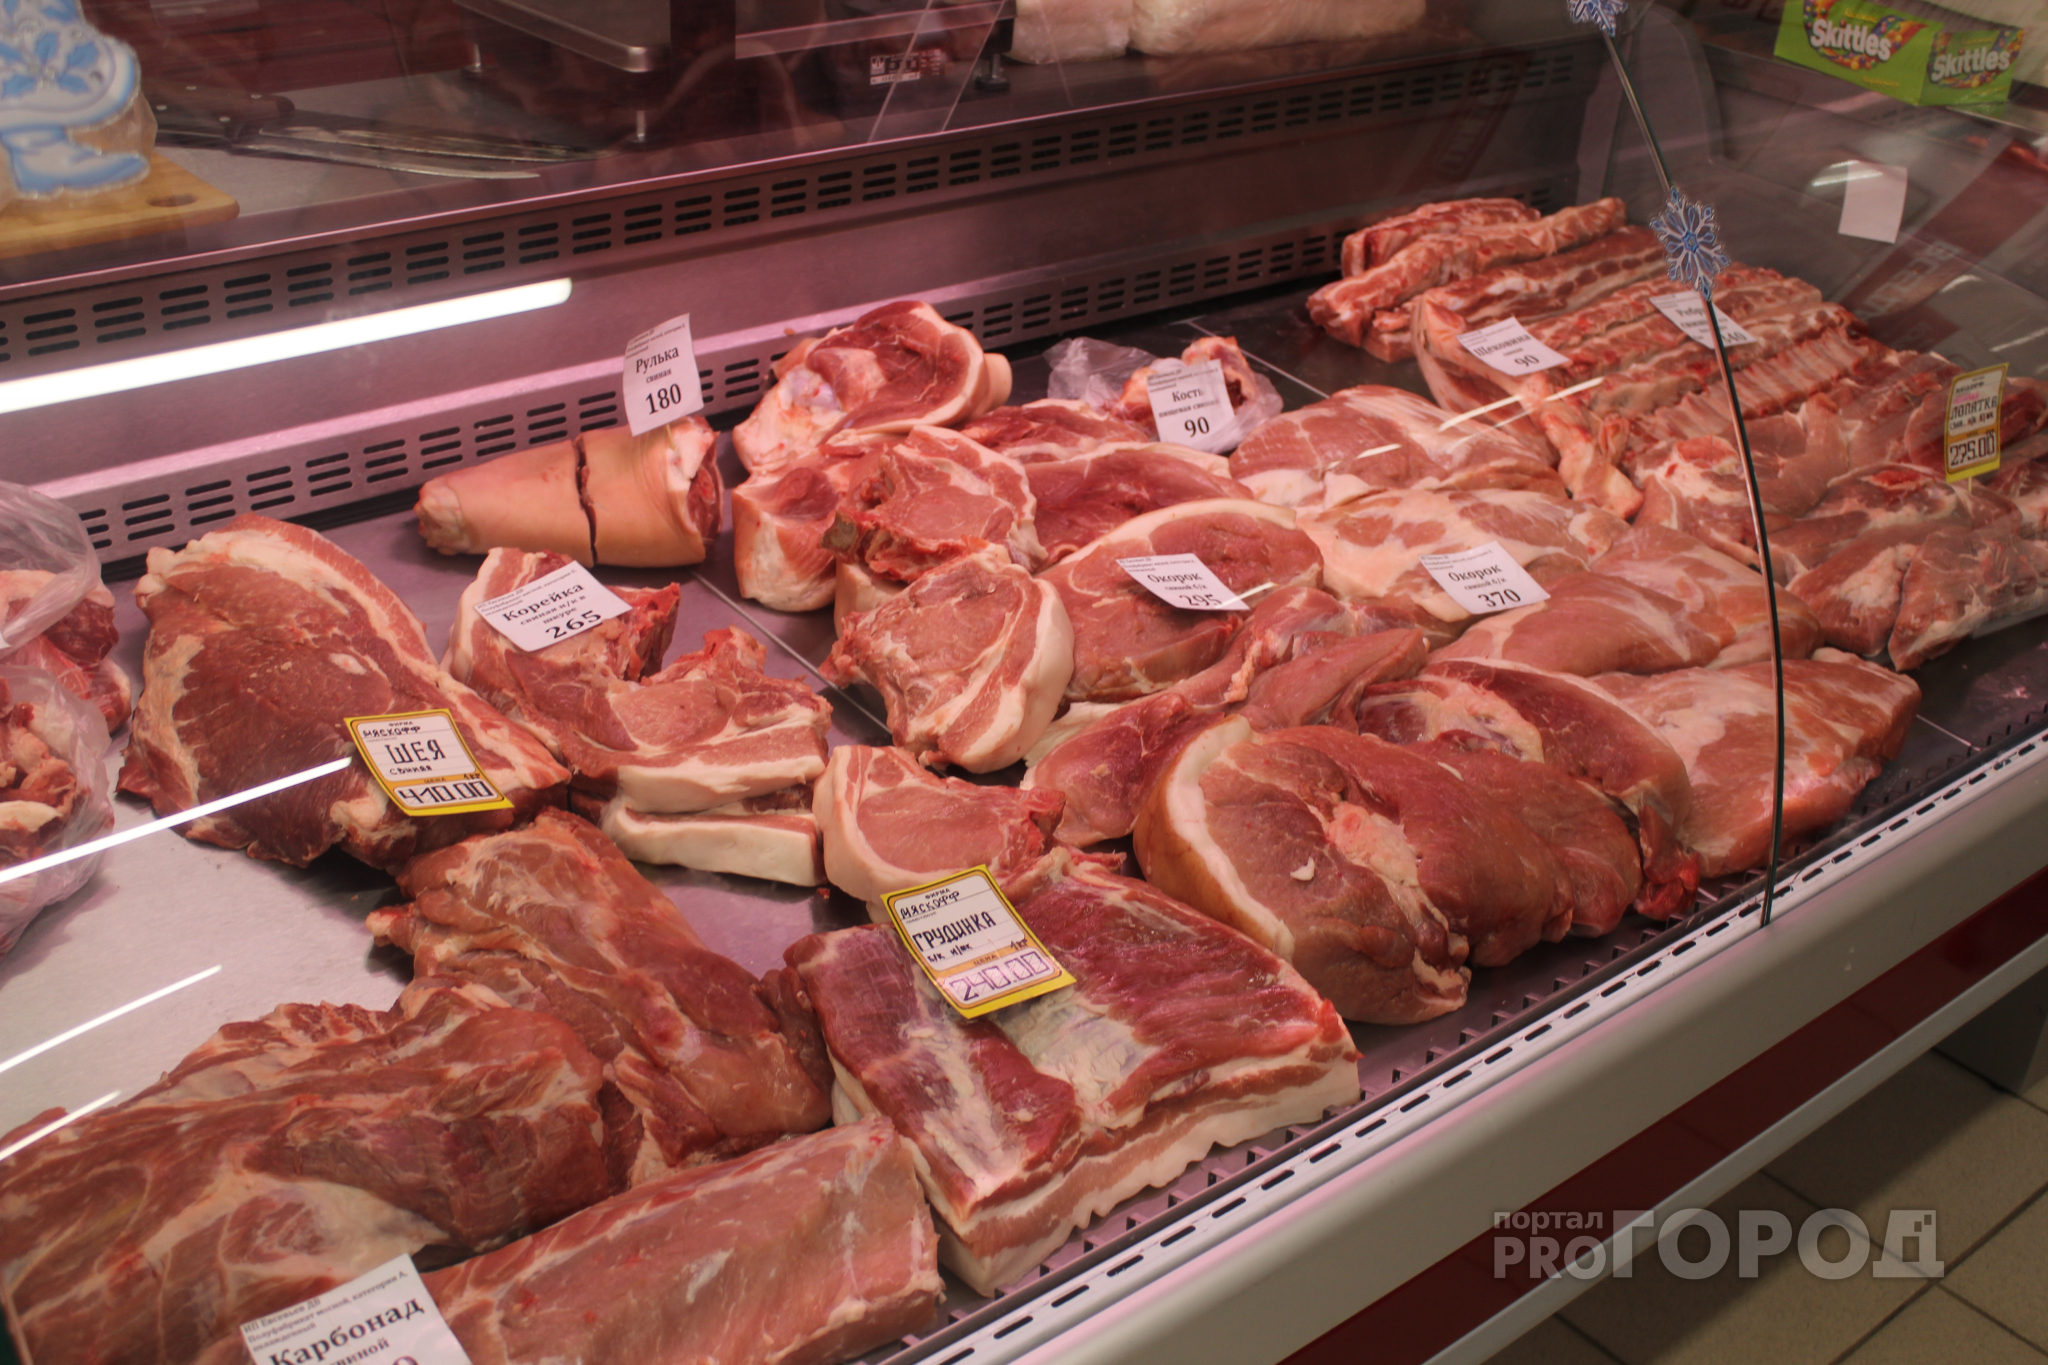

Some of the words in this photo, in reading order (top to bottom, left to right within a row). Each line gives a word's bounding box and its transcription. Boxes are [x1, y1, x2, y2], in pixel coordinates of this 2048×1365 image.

[1810, 19, 1891, 61] Skittles
[1931, 47, 2011, 82] Skittles
[1473, 334, 1531, 356] Щековина
[635, 347, 679, 374] Рулька
[1514, 354, 1540, 367] 90
[646, 368, 672, 384] свиная
[645, 383, 681, 415] 180
[1184, 416, 1210, 438] 90
[1147, 573, 1203, 584] Окорок
[1448, 564, 1502, 582] Окорок
[502, 584, 584, 622] Корейка
[1179, 593, 1223, 607] 295
[1478, 589, 1521, 608] 370
[520, 607, 557, 626] свиная
[543, 607, 577, 624] шкуре
[545, 610, 602, 639] 265
[384, 739, 446, 765] ШЕЯ
[389, 765, 433, 775] свиная
[398, 780, 494, 804] 410.00
[900, 890, 960, 920] МЯСКОФФ
[924, 888, 951, 900] ФИРМА
[912, 910, 997, 952] ГРУДИНКА
[974, 954, 997, 966] ЦЕНА
[950, 950, 1050, 1001] 240.00
[248, 1312, 315, 1343] Полуфабрикат
[352, 1276, 398, 1301] категории
[243, 1322, 260, 1334] ИП
[269, 1298, 426, 1365] Карбонад
